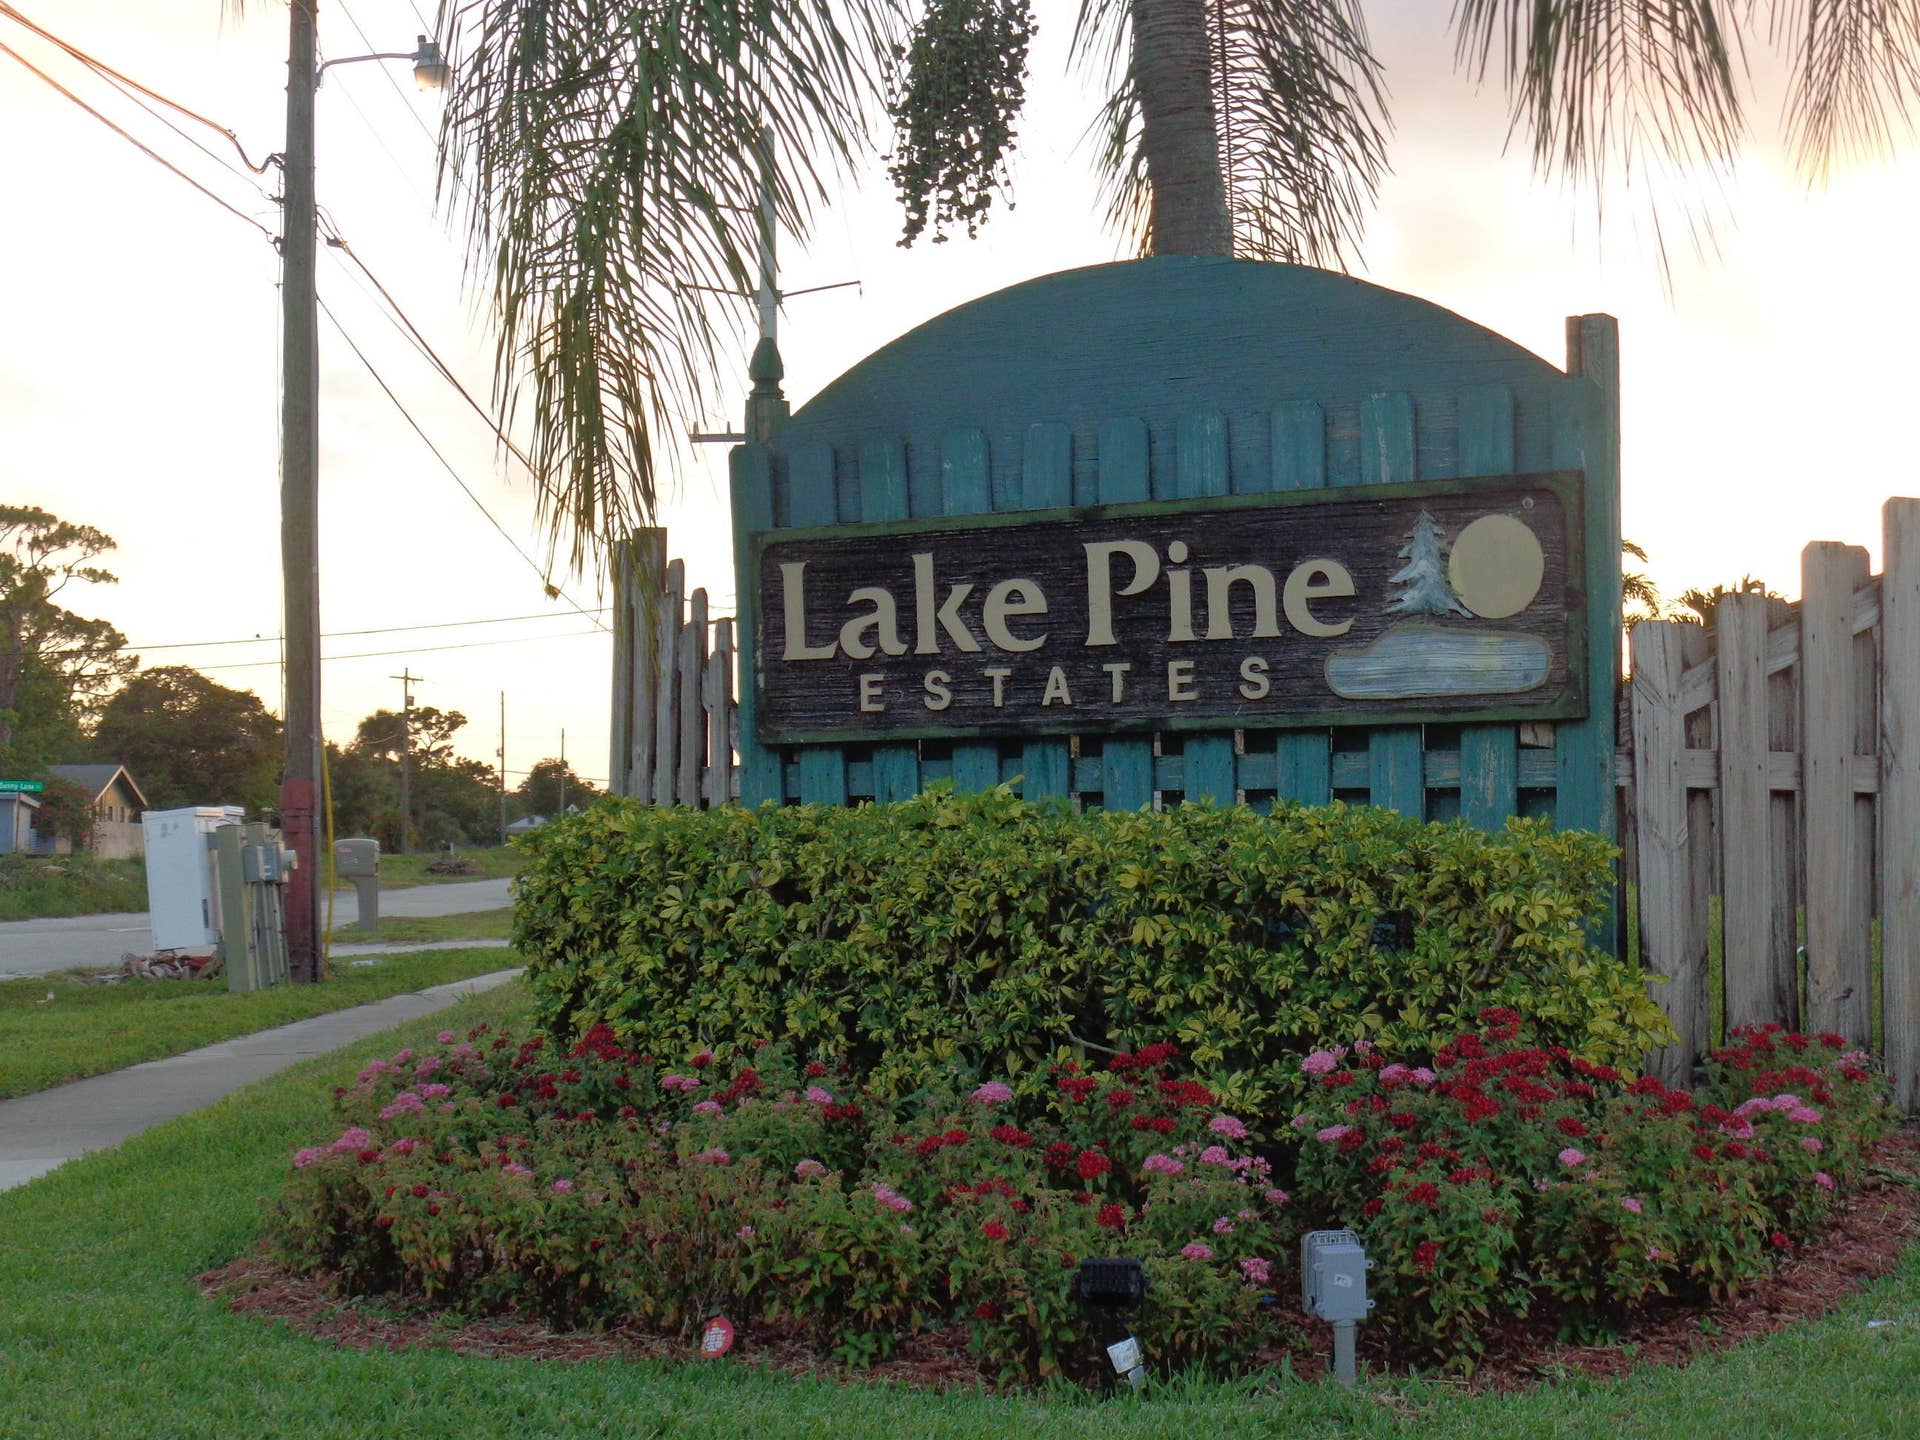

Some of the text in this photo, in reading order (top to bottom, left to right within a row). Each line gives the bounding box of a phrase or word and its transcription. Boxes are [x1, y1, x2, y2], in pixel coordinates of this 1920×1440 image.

[779, 539, 1356, 661] Lake Pine
[859, 656, 1271, 712] ESTATES
